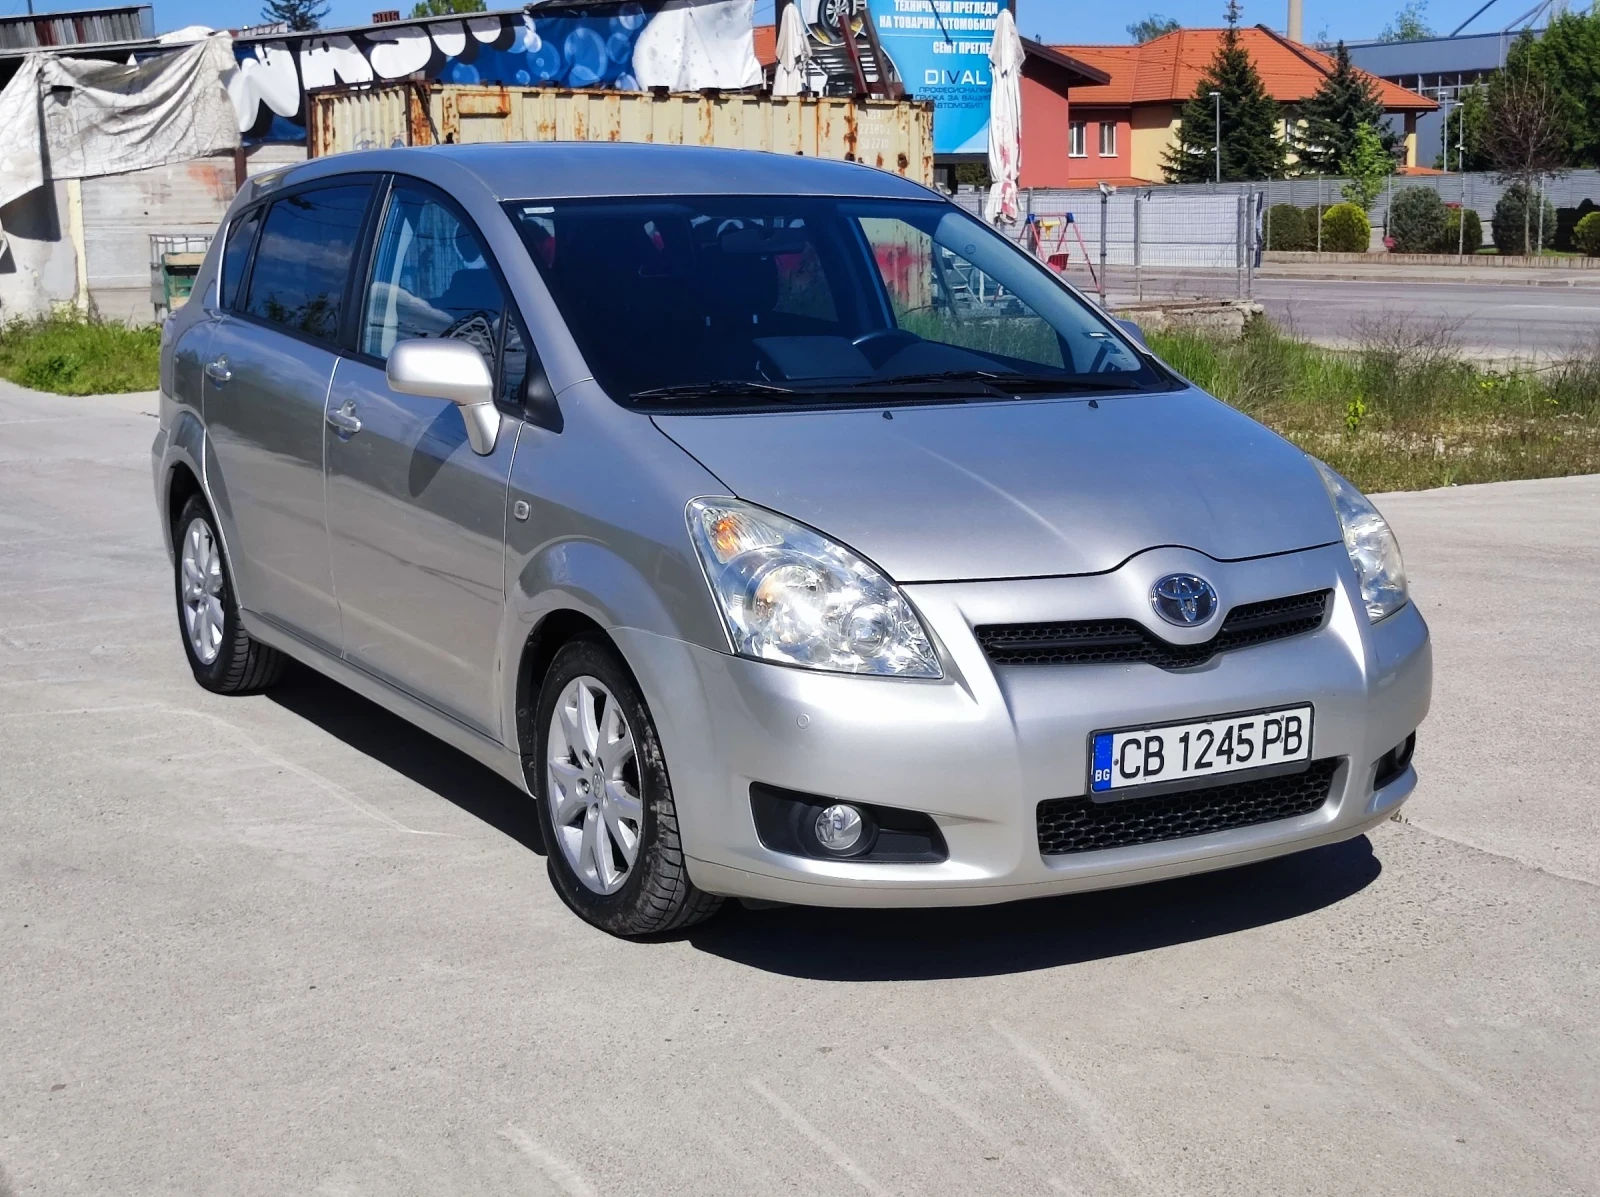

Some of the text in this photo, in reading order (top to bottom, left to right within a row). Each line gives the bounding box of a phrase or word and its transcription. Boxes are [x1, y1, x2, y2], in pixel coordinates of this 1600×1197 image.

[894, 0, 999, 16] ТЕХНИЧЕСКИ ПРЕГЛЕДИ
[879, 15, 892, 28] НА
[893, 16, 936, 29] ТОВАРНИ
[959, 42, 991, 55] ПРЕГЛЕ
[925, 69, 987, 85] DIVAL
[1119, 715, 1303, 779] CB 1245 PB
[1095, 769, 1110, 782] BG
